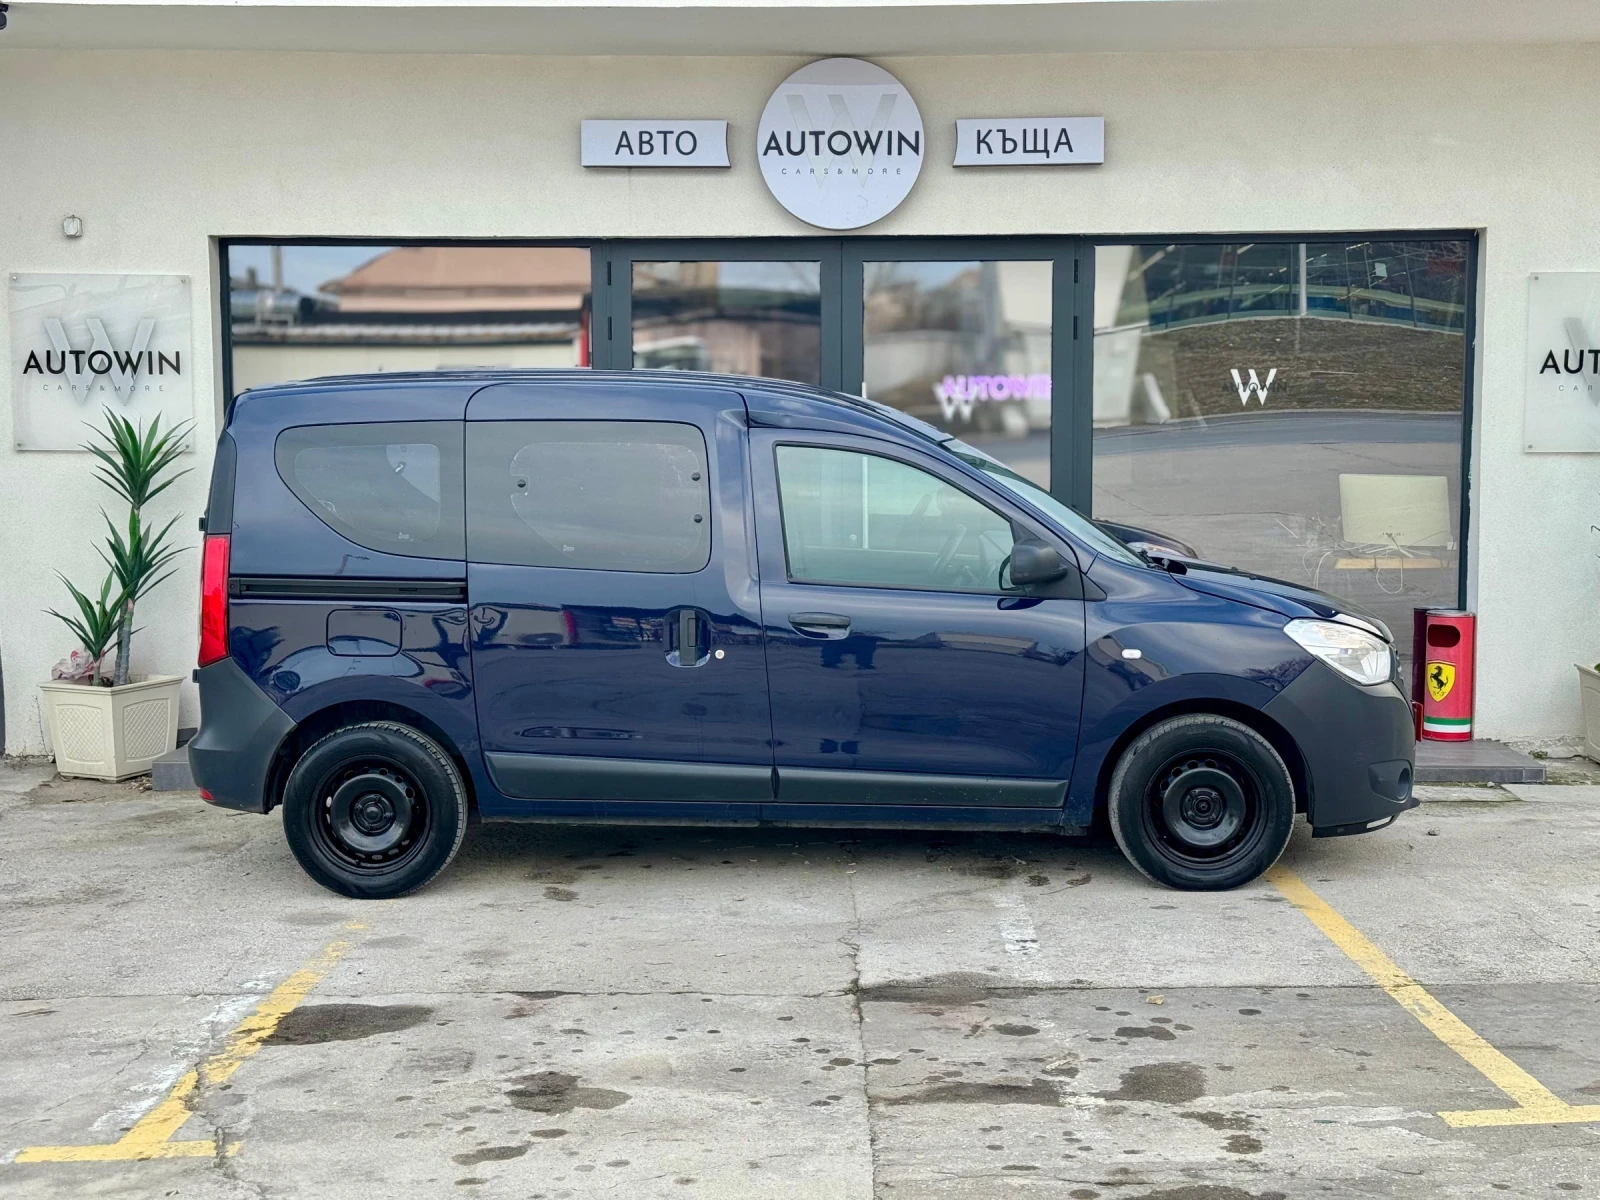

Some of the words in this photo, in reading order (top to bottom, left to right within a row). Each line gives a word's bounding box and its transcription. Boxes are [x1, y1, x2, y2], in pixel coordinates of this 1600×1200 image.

[614, 130, 698, 156] АВТО
[762, 129, 920, 157] AUTOWIN
[976, 127, 1074, 159] КЪЩА
[22, 349, 181, 376] AUTOWIN
[1539, 348, 1600, 375] AUT
